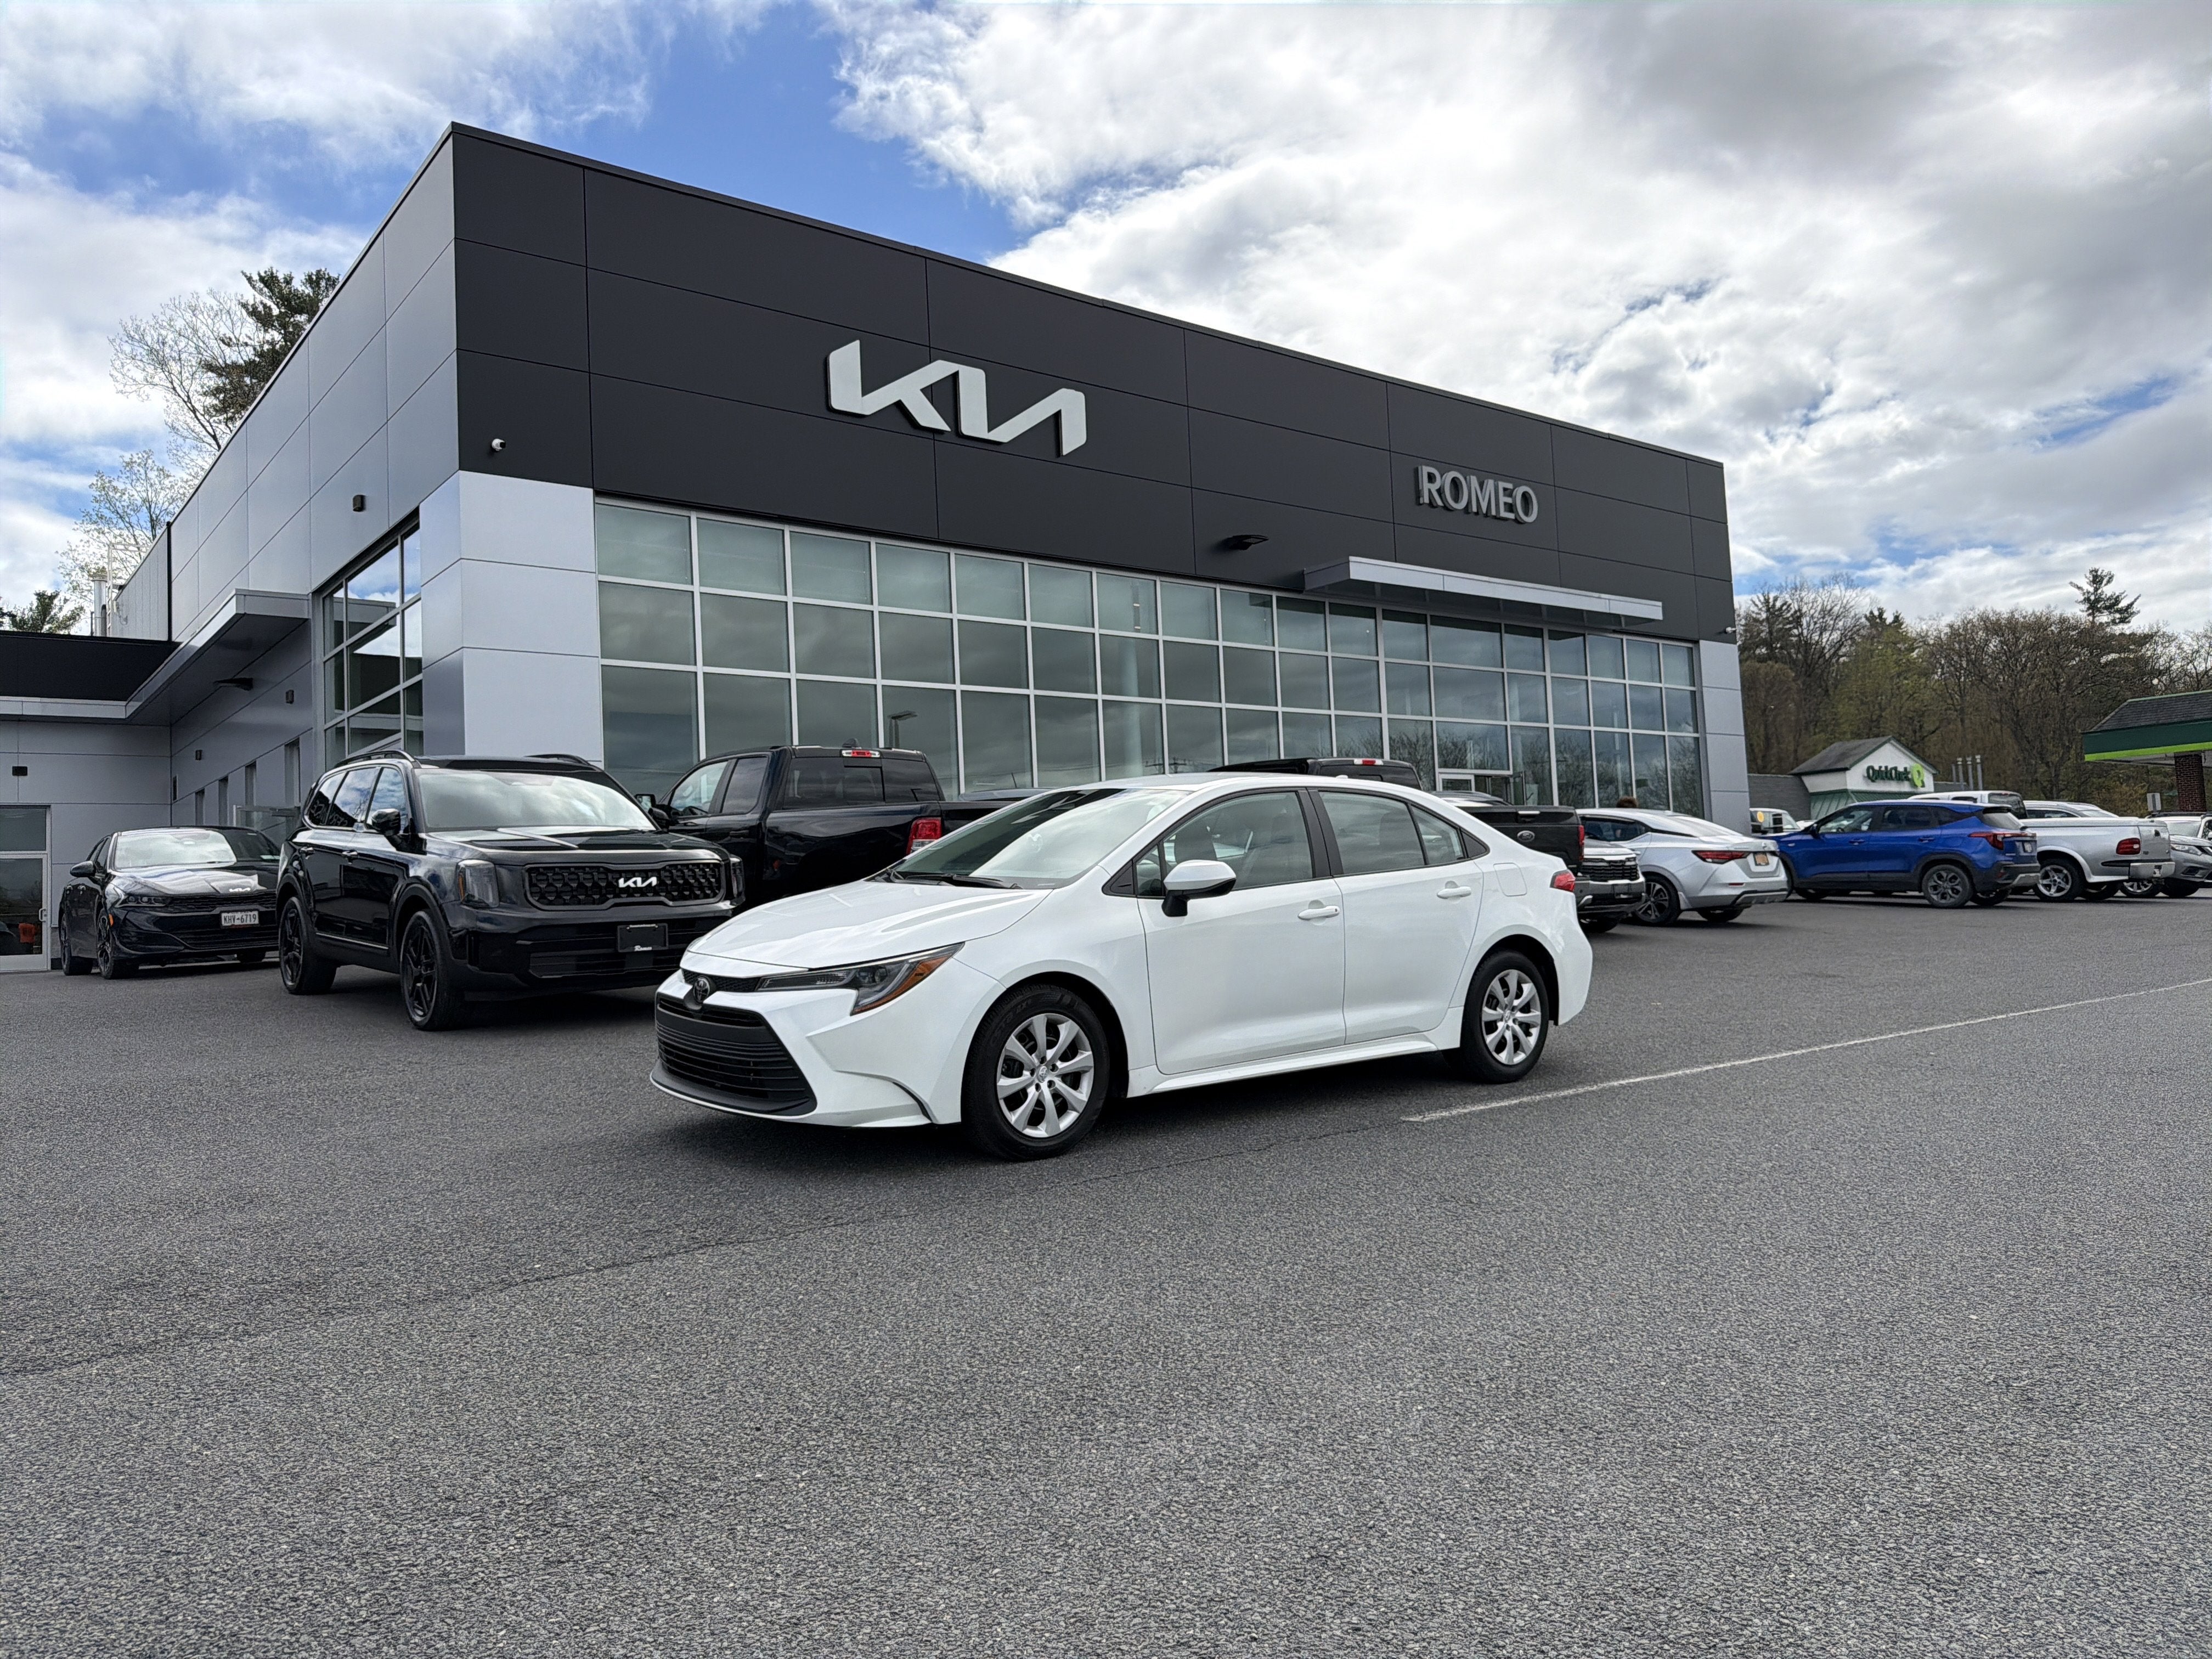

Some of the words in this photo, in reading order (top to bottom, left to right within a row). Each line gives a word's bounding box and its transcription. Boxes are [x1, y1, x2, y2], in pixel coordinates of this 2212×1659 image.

[828, 340, 1087, 455] KIA
[1419, 466, 1538, 523] ROMEO
[618, 876, 657, 888] KIA
